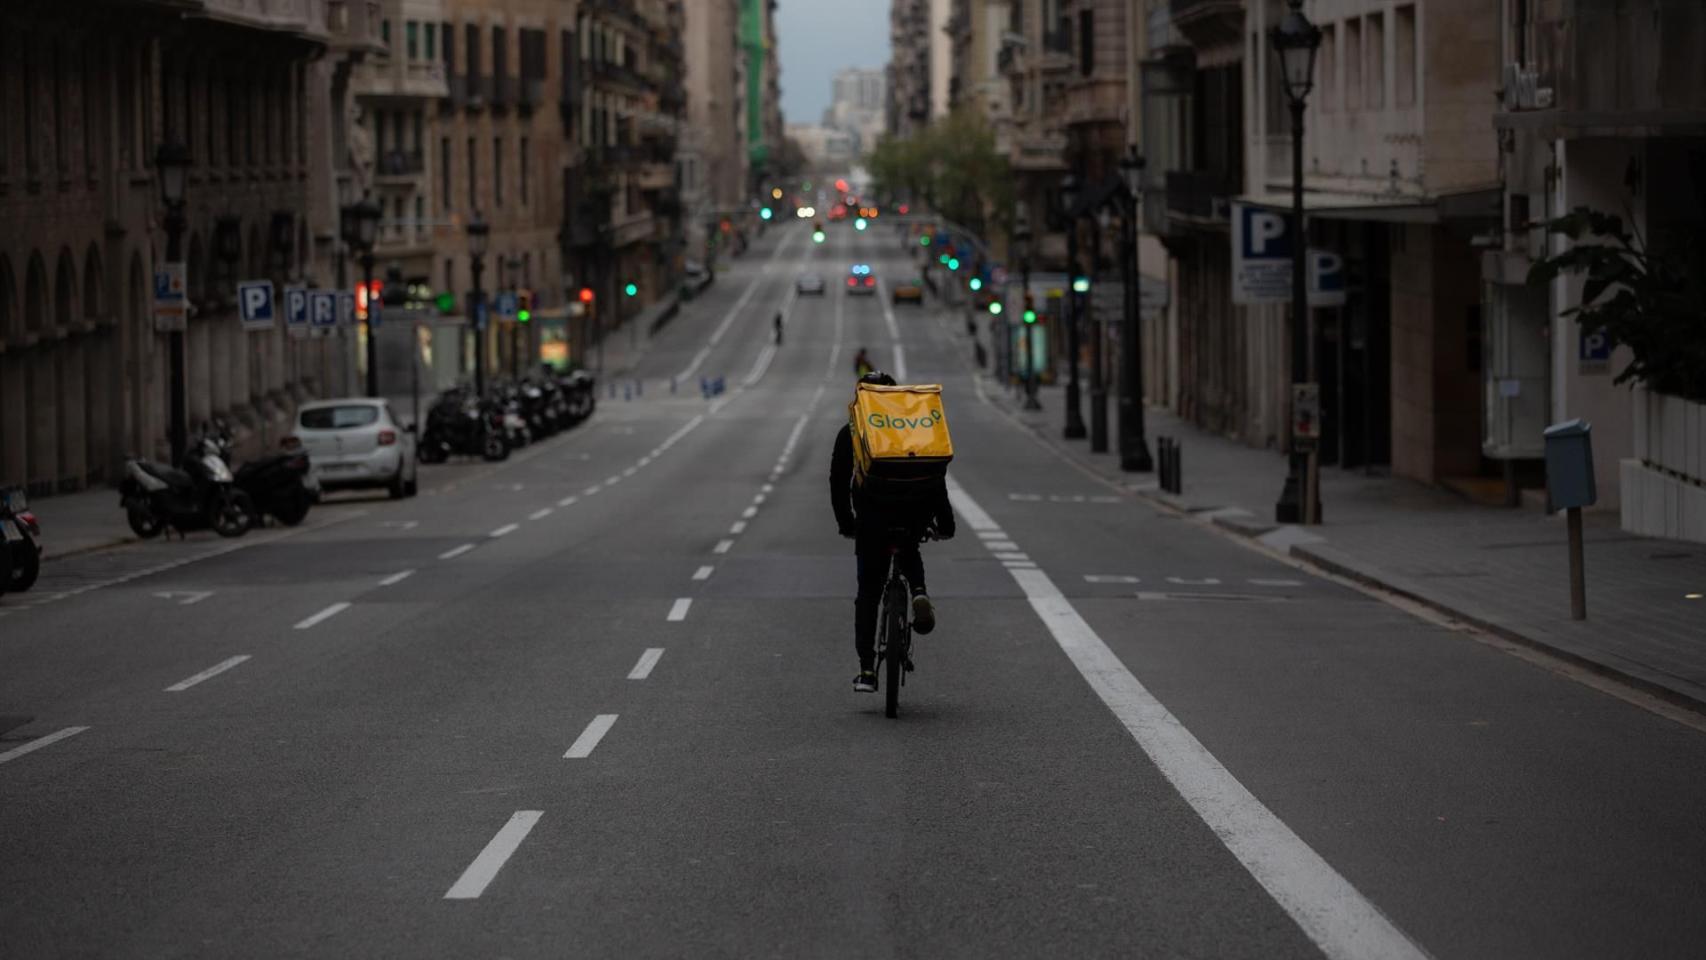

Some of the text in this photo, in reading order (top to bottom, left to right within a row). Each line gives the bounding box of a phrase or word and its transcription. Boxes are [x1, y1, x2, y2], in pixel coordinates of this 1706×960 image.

[1250, 211, 1286, 255] P
[1311, 252, 1342, 291] P
[245, 287, 267, 319] P
[290, 291, 304, 320] P
[1585, 334, 1605, 358] P
[869, 413, 934, 429] Glovo
